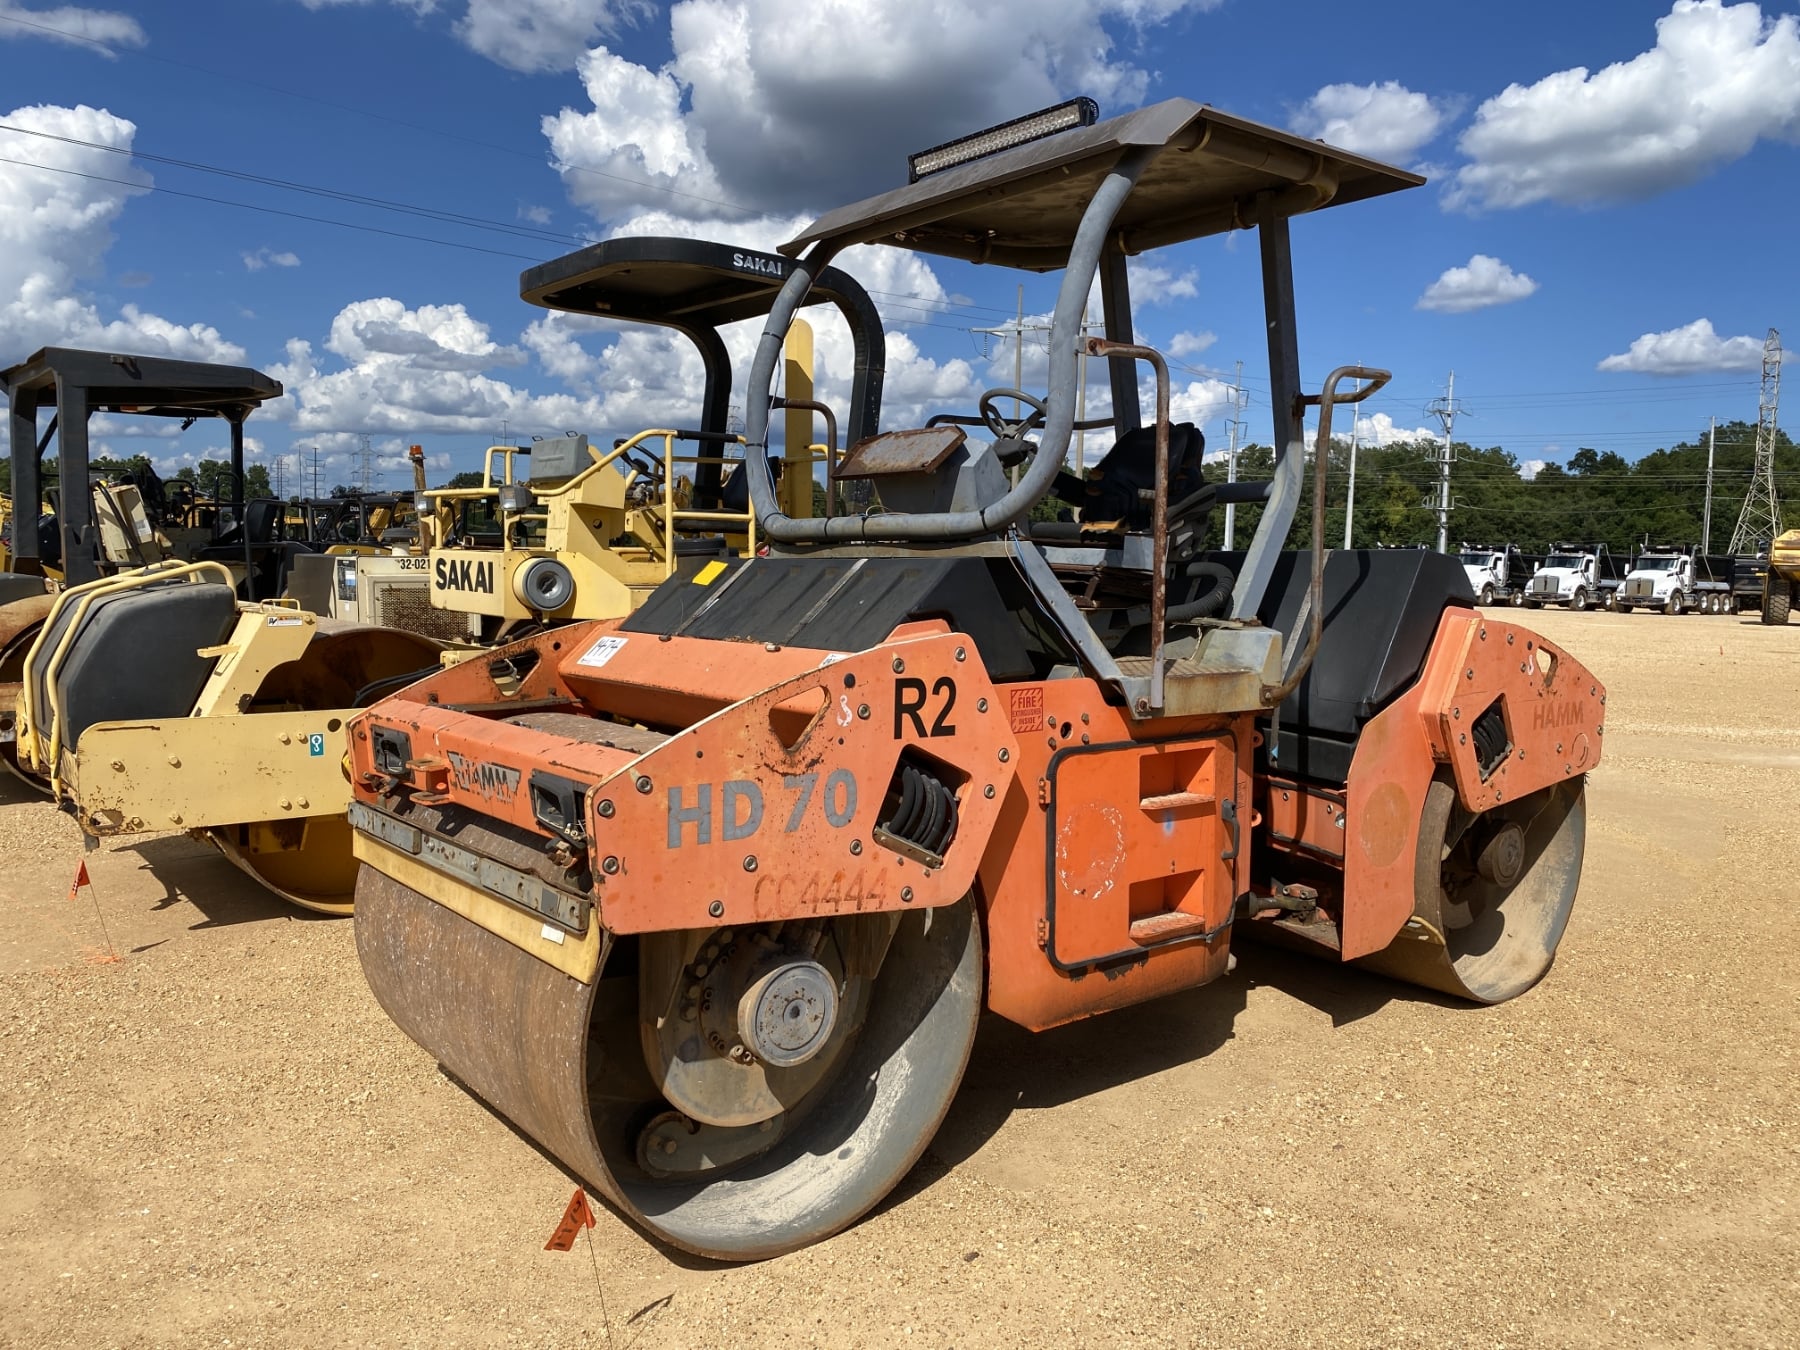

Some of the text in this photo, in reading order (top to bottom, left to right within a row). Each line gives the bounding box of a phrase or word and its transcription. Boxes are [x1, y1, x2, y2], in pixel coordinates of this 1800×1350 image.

[733, 253, 782, 275] SAKAI
[435, 557, 494, 594] SAKAI
[894, 676, 957, 740] R2
[1018, 695, 1037, 709] FIRE
[1533, 700, 1584, 730] HAMM
[667, 767, 858, 849] HD 70
